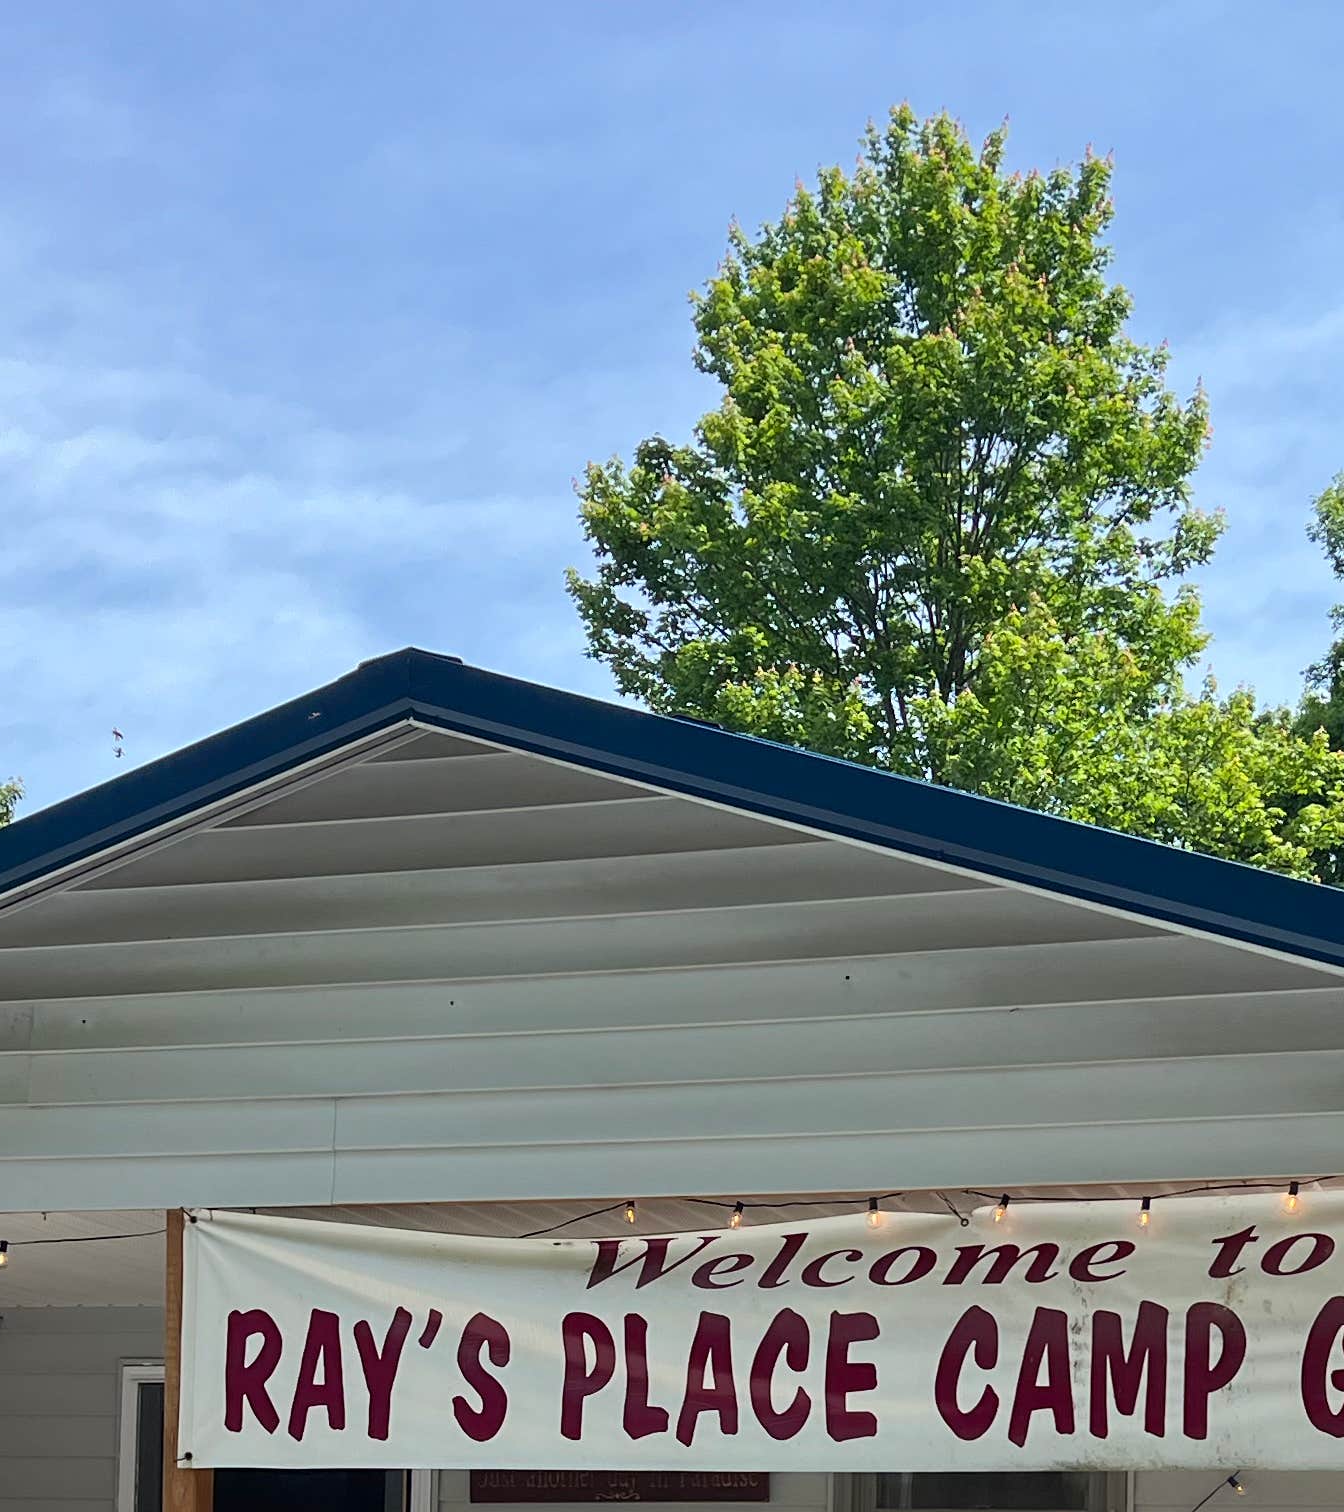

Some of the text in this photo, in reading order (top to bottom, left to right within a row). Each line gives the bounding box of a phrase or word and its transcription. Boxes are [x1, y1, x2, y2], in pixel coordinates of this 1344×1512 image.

[585, 1224, 1336, 1291] Welcome to
[223, 1305, 511, 1442] RAY'S
[559, 1307, 880, 1448] PLACE
[934, 1300, 1247, 1449] CAMP
